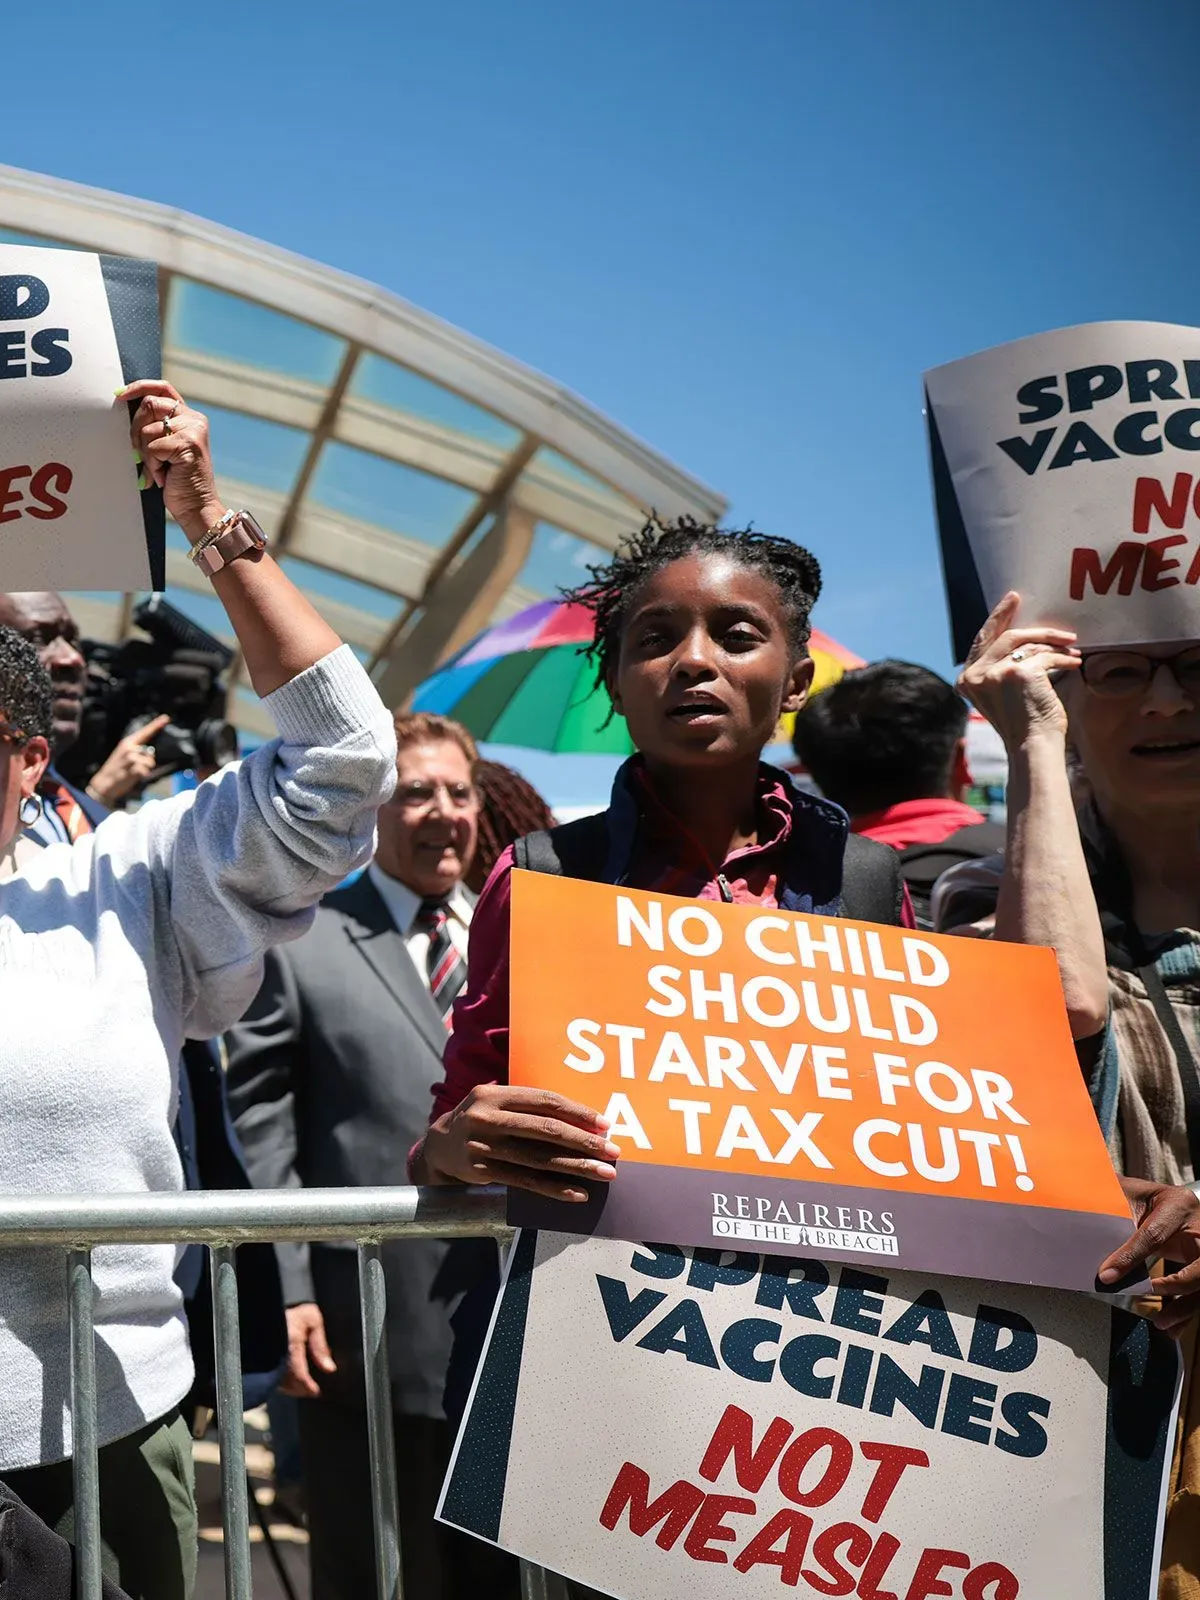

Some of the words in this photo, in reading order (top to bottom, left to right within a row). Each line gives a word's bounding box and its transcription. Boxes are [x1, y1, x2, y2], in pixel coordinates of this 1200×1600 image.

[1133, 472, 1200, 534] N
[616, 896, 723, 957] NO
[745, 916, 950, 987] CHILD
[645, 965, 939, 1047] SHOULD
[563, 1019, 853, 1101] STARVE
[873, 1052, 1031, 1126] FOR
[603, 1093, 653, 1150] A
[668, 1099, 834, 1170] TAX
[853, 1119, 1035, 1192] CUT!
[711, 1193, 896, 1235] REPAIRERS
[716, 1220, 741, 1236] OF
[750, 1223, 790, 1241] THE
[816, 1230, 894, 1253] BREACH
[595, 1273, 1051, 1458] VACCINES
[699, 1404, 930, 1524] NOT
